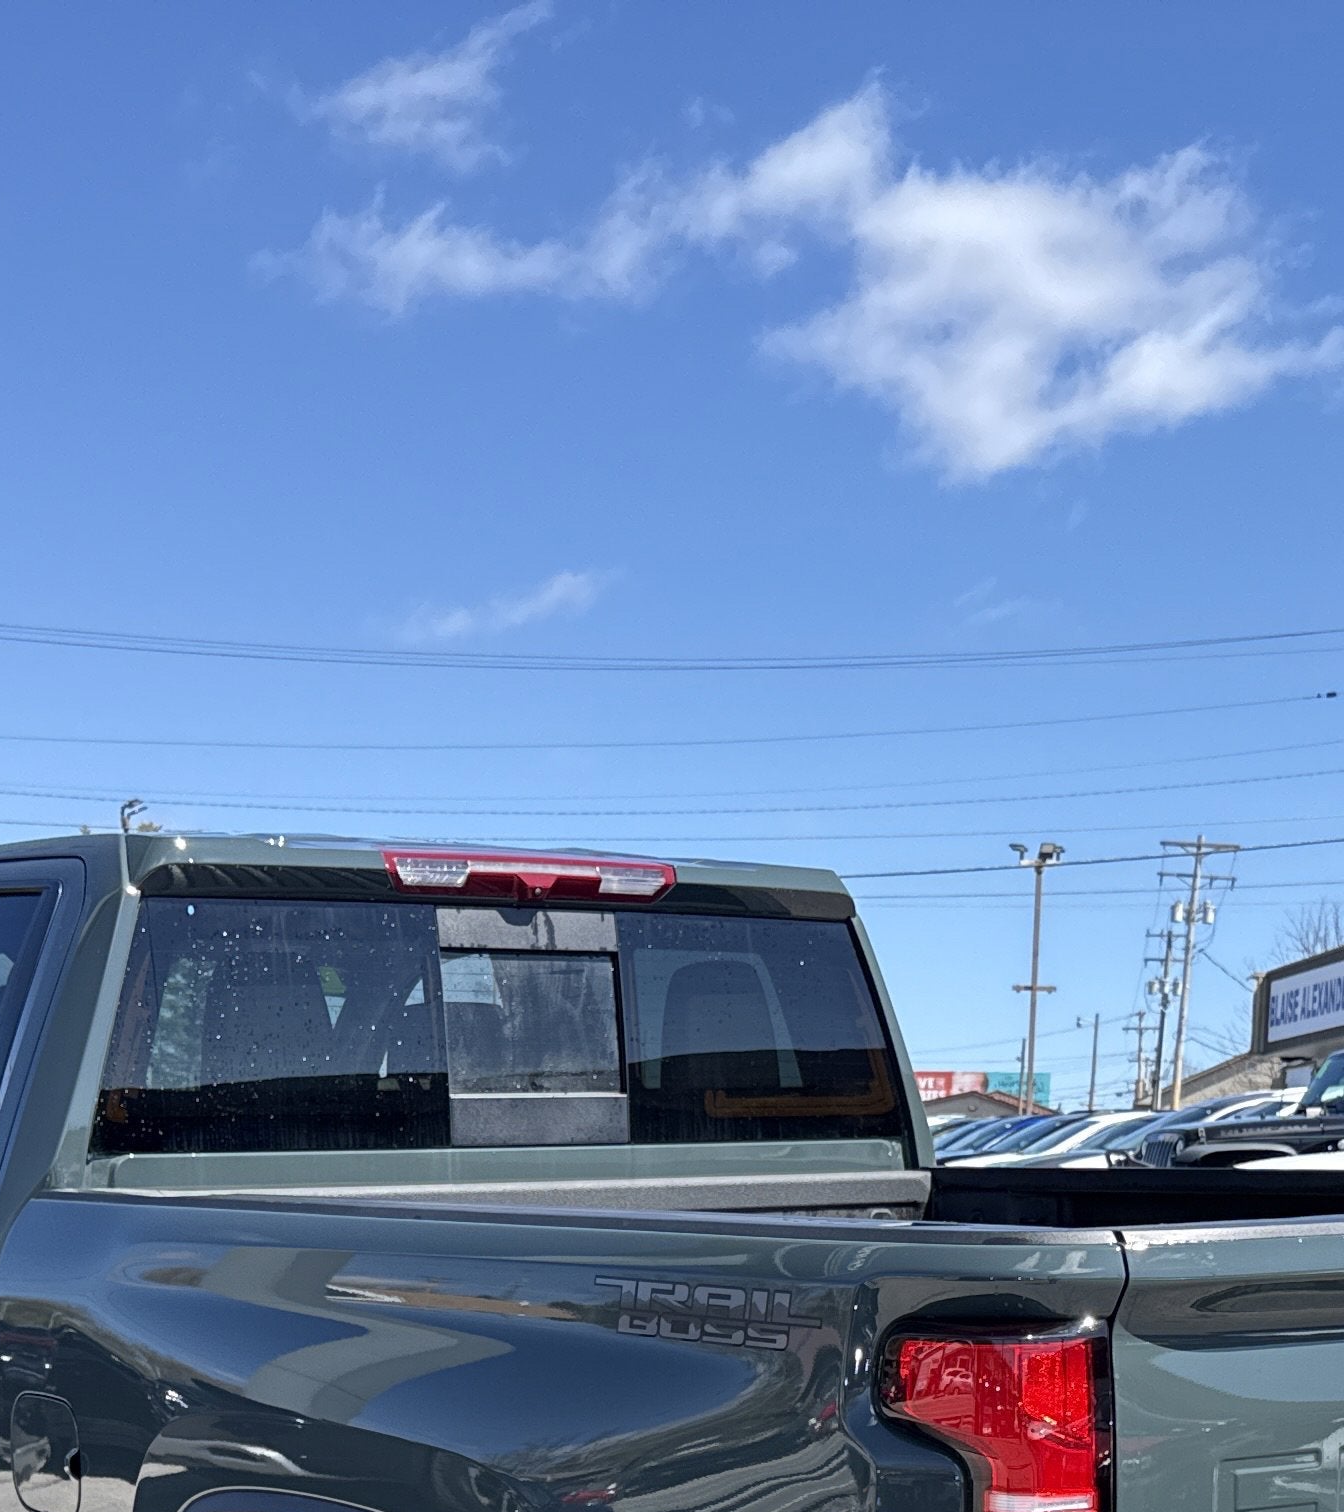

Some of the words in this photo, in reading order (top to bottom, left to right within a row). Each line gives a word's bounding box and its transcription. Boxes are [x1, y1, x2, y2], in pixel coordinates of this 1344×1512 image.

[1269, 987, 1300, 1028] BLAISE
[594, 1274, 823, 1329] TRAIL
[616, 1311, 790, 1351] BOSS
